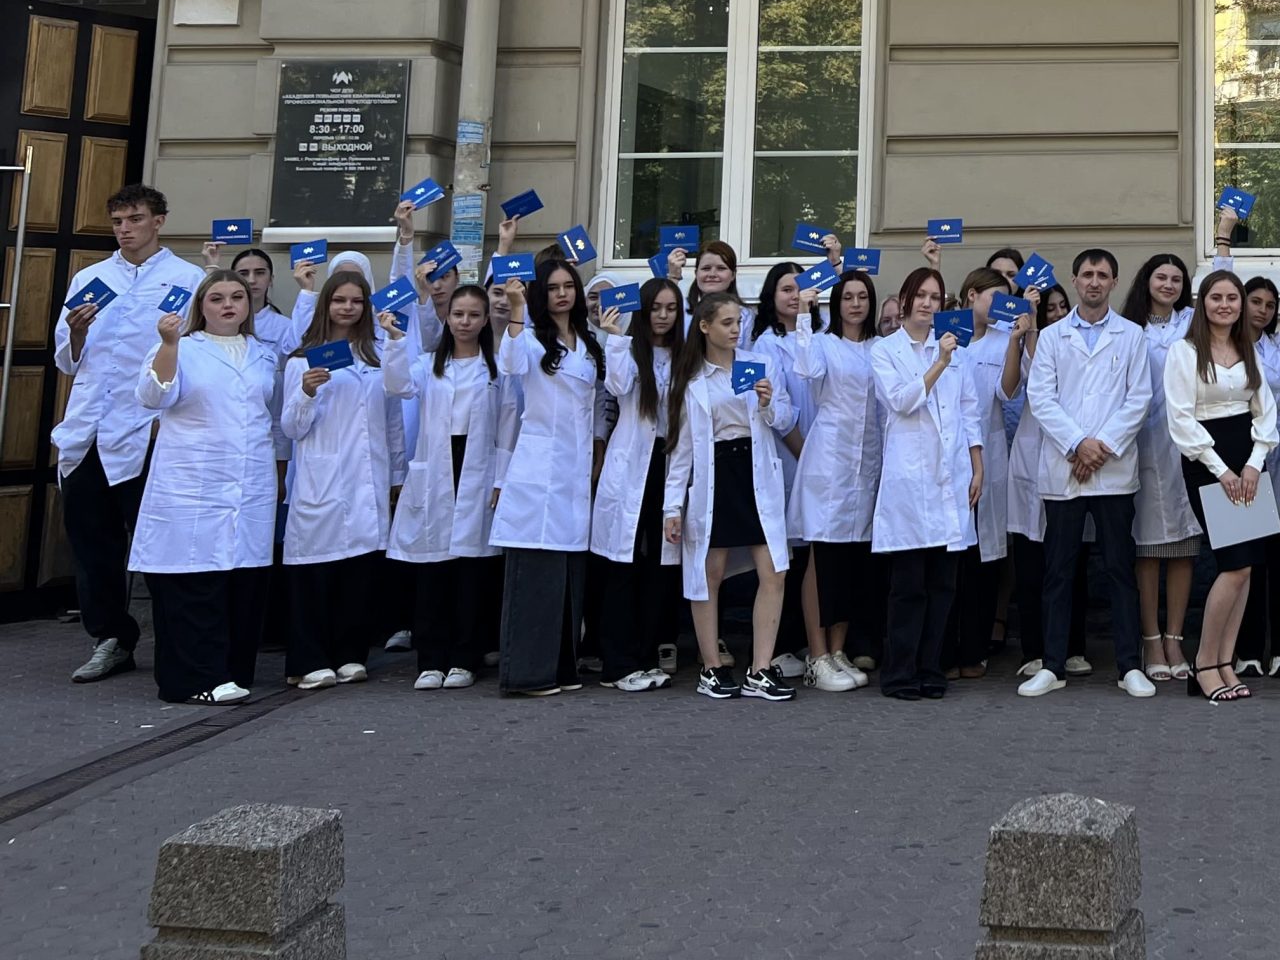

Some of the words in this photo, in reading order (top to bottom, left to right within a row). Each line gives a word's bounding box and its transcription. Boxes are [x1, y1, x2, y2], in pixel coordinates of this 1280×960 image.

[309, 125, 330, 134] 8:30
[339, 125, 365, 134] 17:00
[321, 142, 373, 151] ВЫХОДНОЙ
